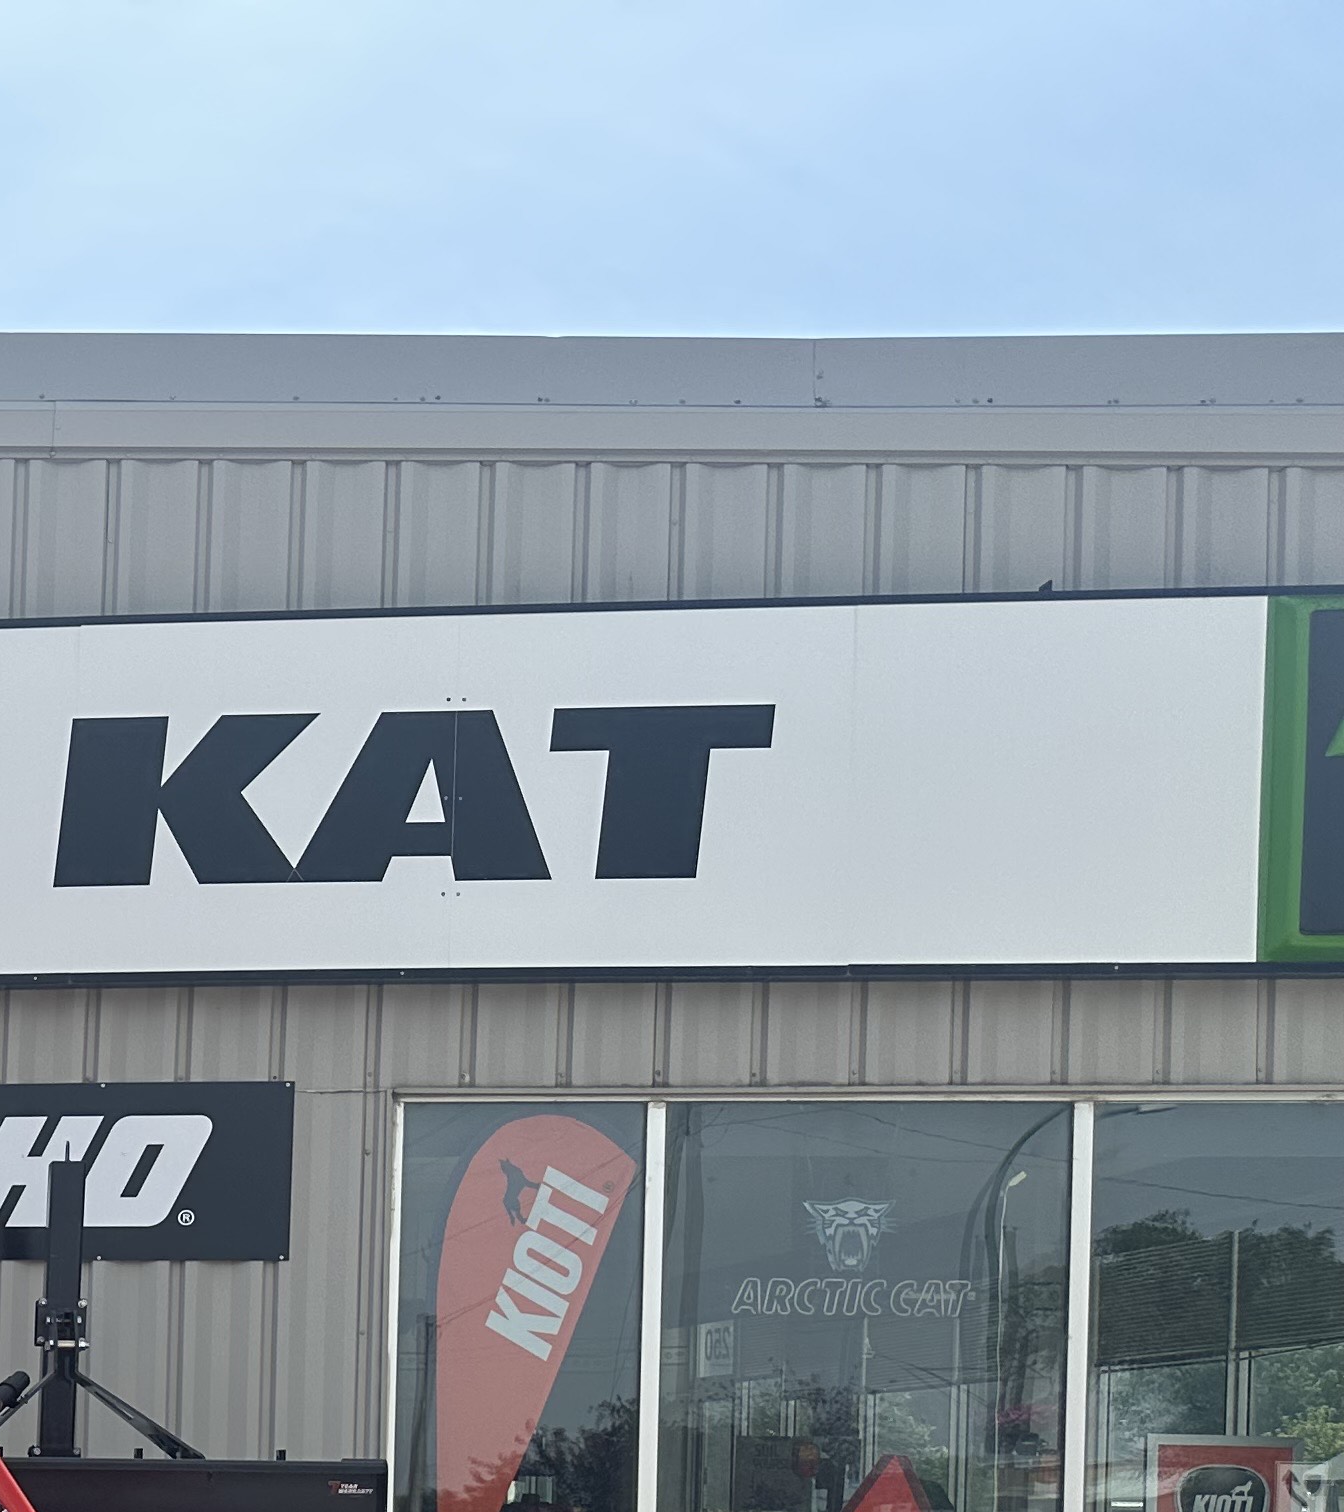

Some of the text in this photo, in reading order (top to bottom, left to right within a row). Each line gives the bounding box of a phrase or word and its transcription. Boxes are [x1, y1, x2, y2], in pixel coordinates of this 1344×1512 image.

[53, 704, 776, 888] KAT
[485, 1165, 610, 1361] KIOTI
[731, 1278, 972, 1317] ARCTIC CAT
